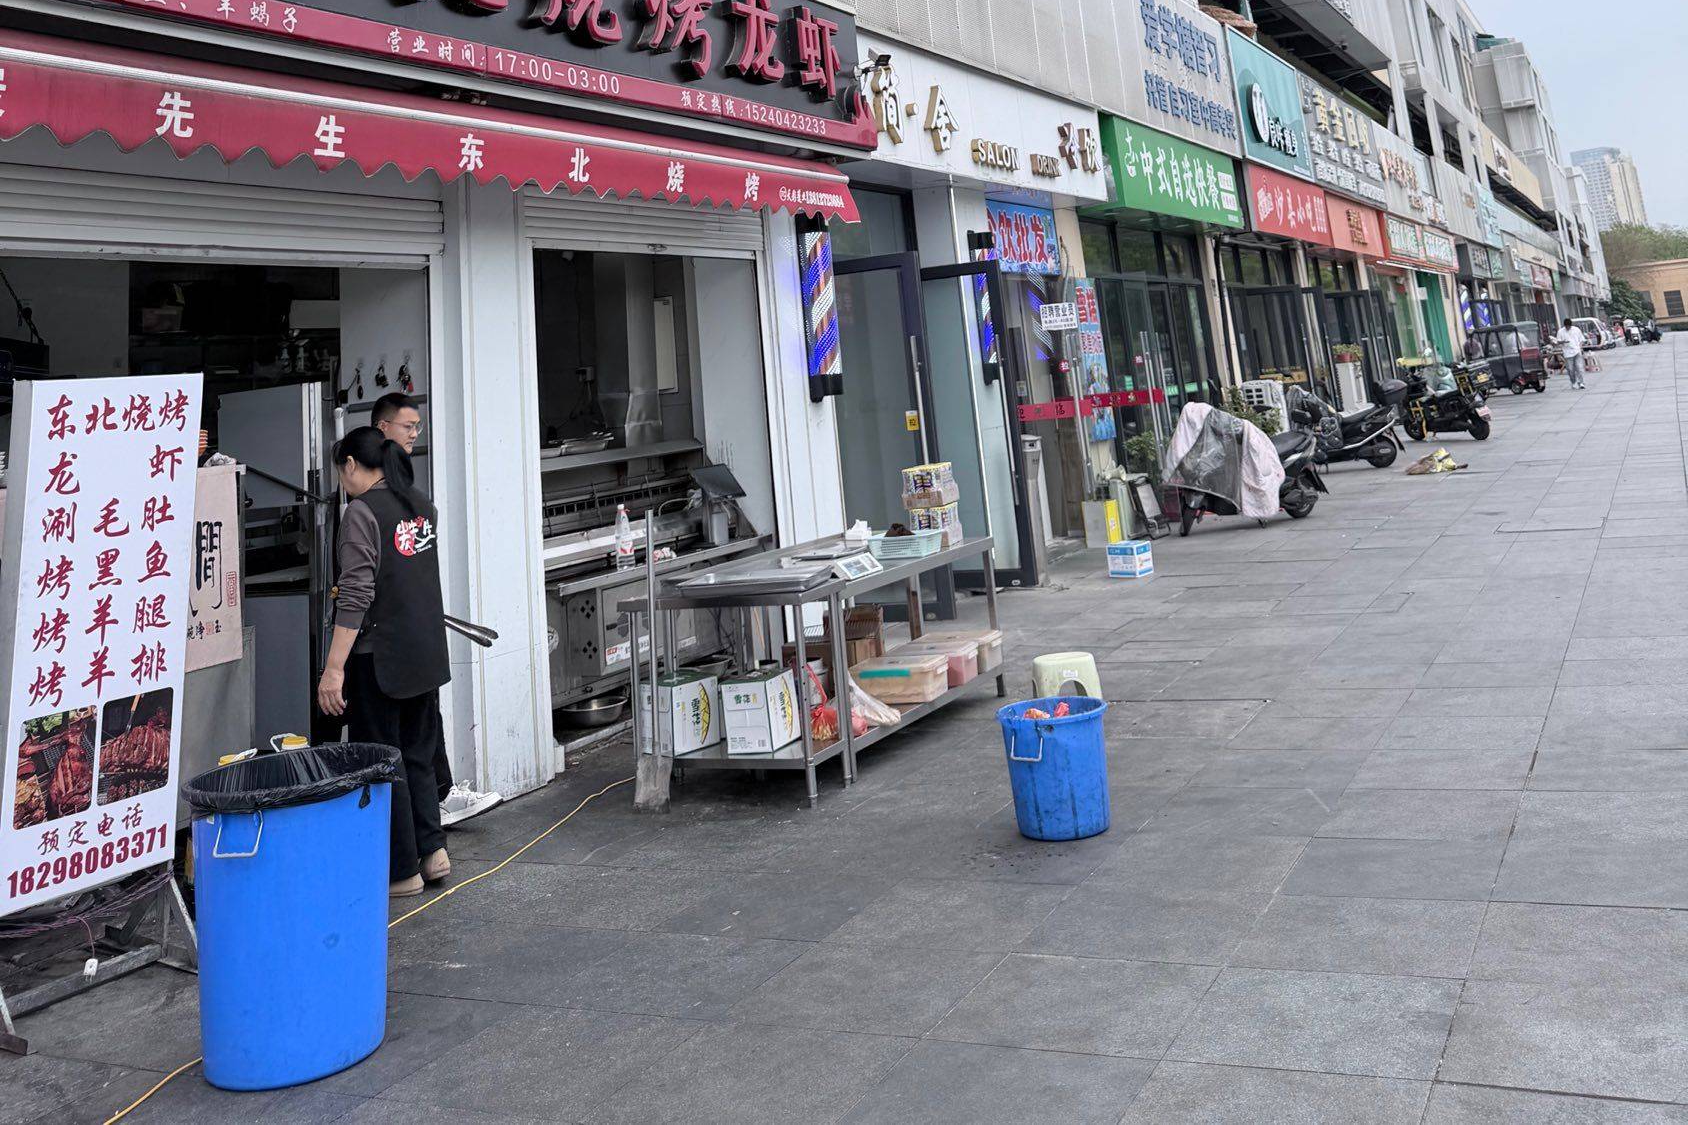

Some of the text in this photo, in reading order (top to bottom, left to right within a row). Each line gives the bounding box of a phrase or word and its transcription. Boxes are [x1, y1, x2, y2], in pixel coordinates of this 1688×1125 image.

[0, 67, 760, 204] 先生东北烧烤
[972, 138, 1021, 172] SALON
[47, 388, 190, 441] 东北烧烤
[37, 802, 144, 856] 预定电话
[7, 823, 168, 899] 18298083371
